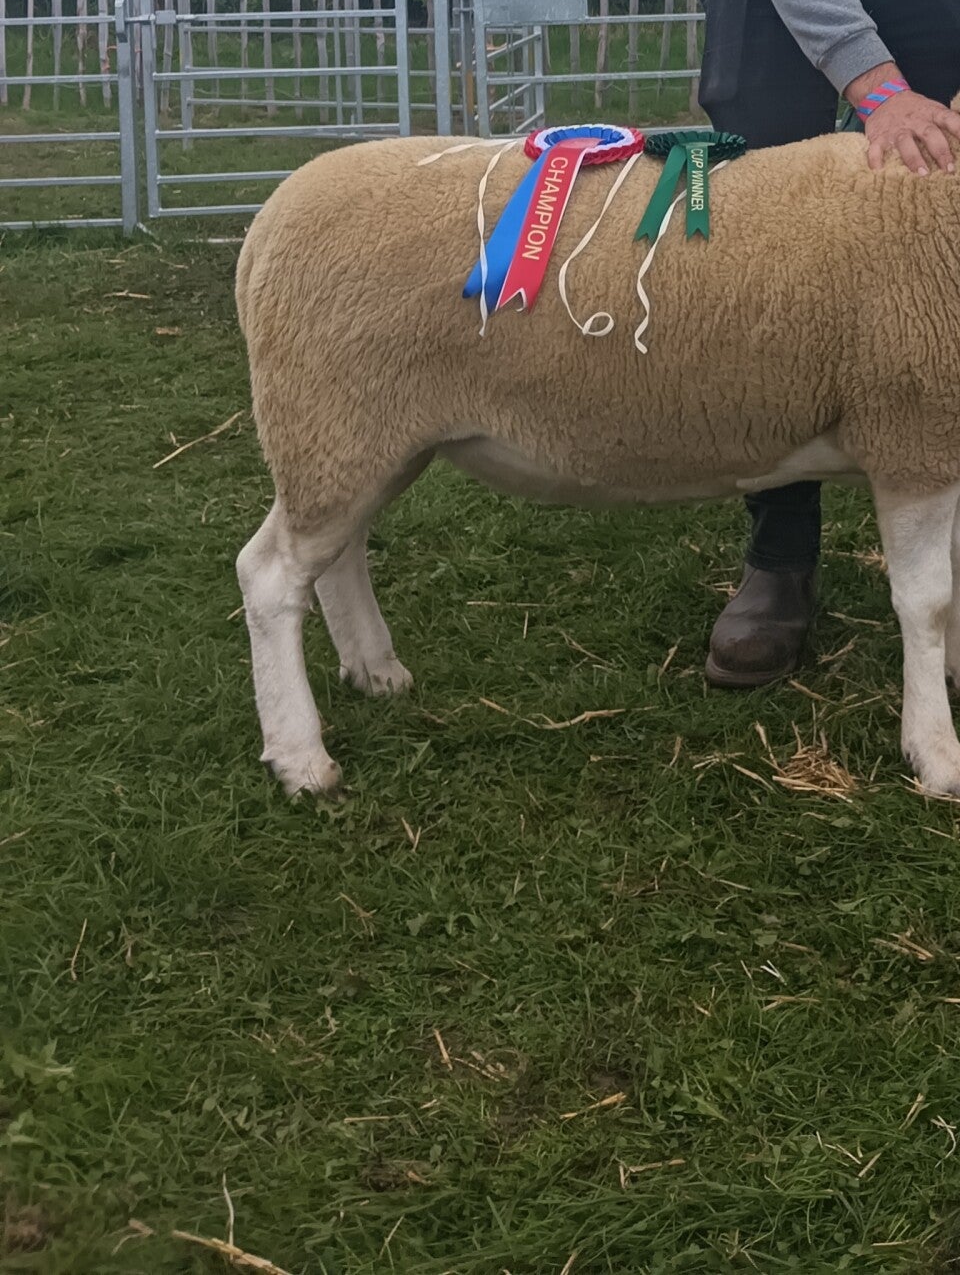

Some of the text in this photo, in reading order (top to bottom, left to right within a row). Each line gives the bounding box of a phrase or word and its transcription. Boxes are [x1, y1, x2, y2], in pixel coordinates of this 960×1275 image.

[521, 156, 569, 261] CHAMPION
[690, 148, 705, 212] CUP WINNER
